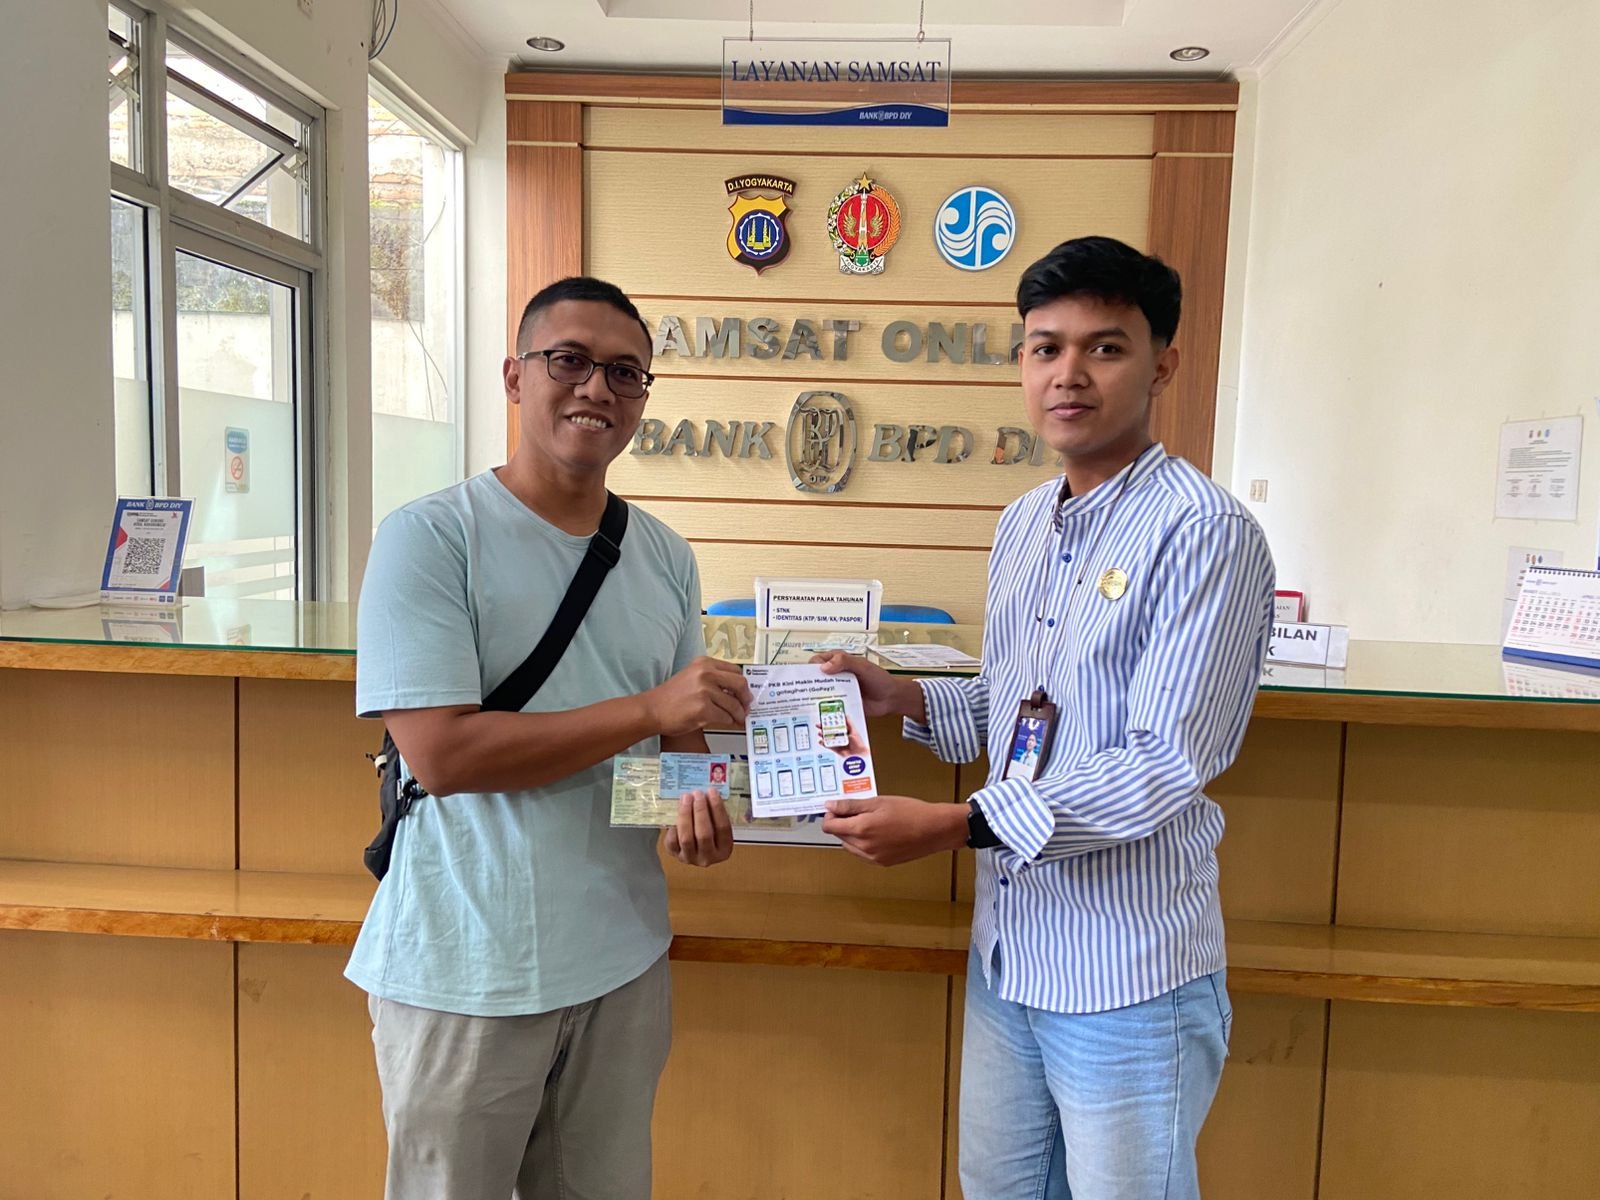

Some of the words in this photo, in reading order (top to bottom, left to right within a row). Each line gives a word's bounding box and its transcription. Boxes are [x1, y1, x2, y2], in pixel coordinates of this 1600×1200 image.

[731, 61, 840, 82] LAYANAN
[847, 61, 942, 82] SAMSAT
[859, 111, 878, 120] BANK
[884, 111, 899, 120] BPD
[899, 111, 912, 120] DIY
[641, 315, 860, 363] AMSAT
[629, 418, 775, 460] BANK
[868, 424, 975, 464] BPD
[991, 427, 1064, 467] DI
